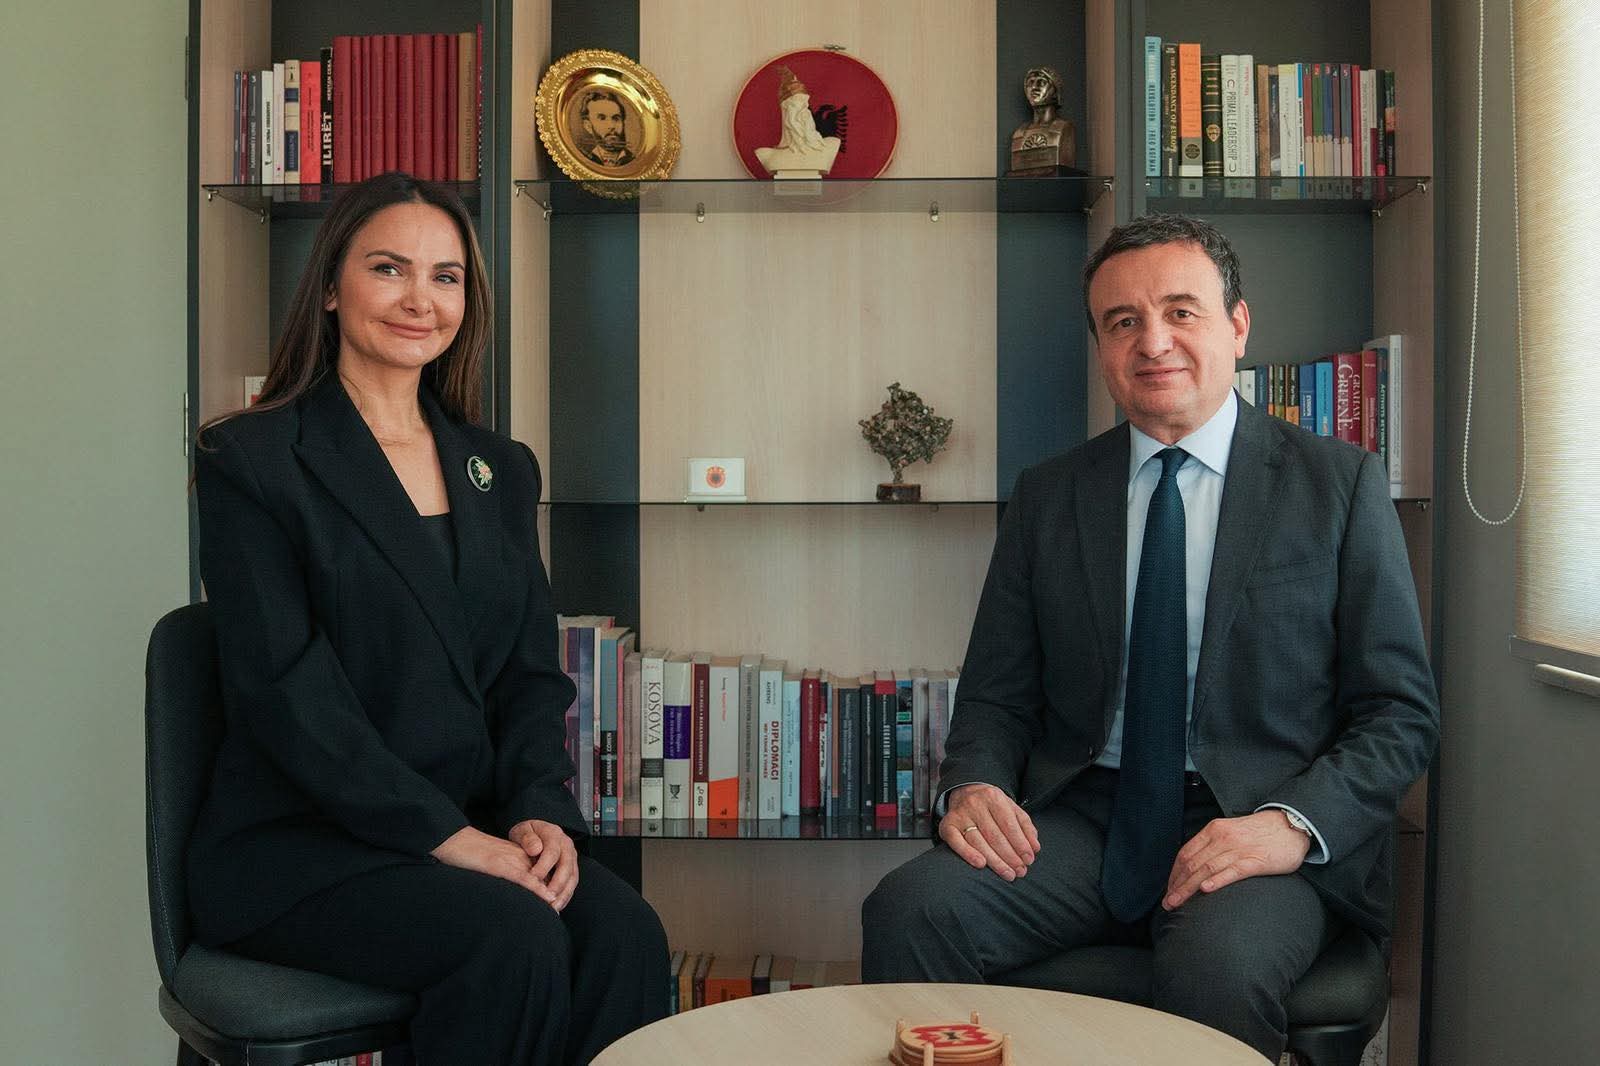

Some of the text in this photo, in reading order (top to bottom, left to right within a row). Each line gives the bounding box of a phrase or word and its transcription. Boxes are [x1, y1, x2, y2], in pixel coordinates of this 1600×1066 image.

[1148, 84, 1156, 122] REVOLUTION
[1227, 91, 1238, 160] PRIMAL LEADERSHIP
[322, 112, 333, 166] ILIRËT
[1337, 363, 1354, 431] GREENE
[1352, 374, 1361, 421] GRAHAM
[648, 681, 662, 745] KOSOVA
[771, 720, 779, 780] DIPLOMACI
